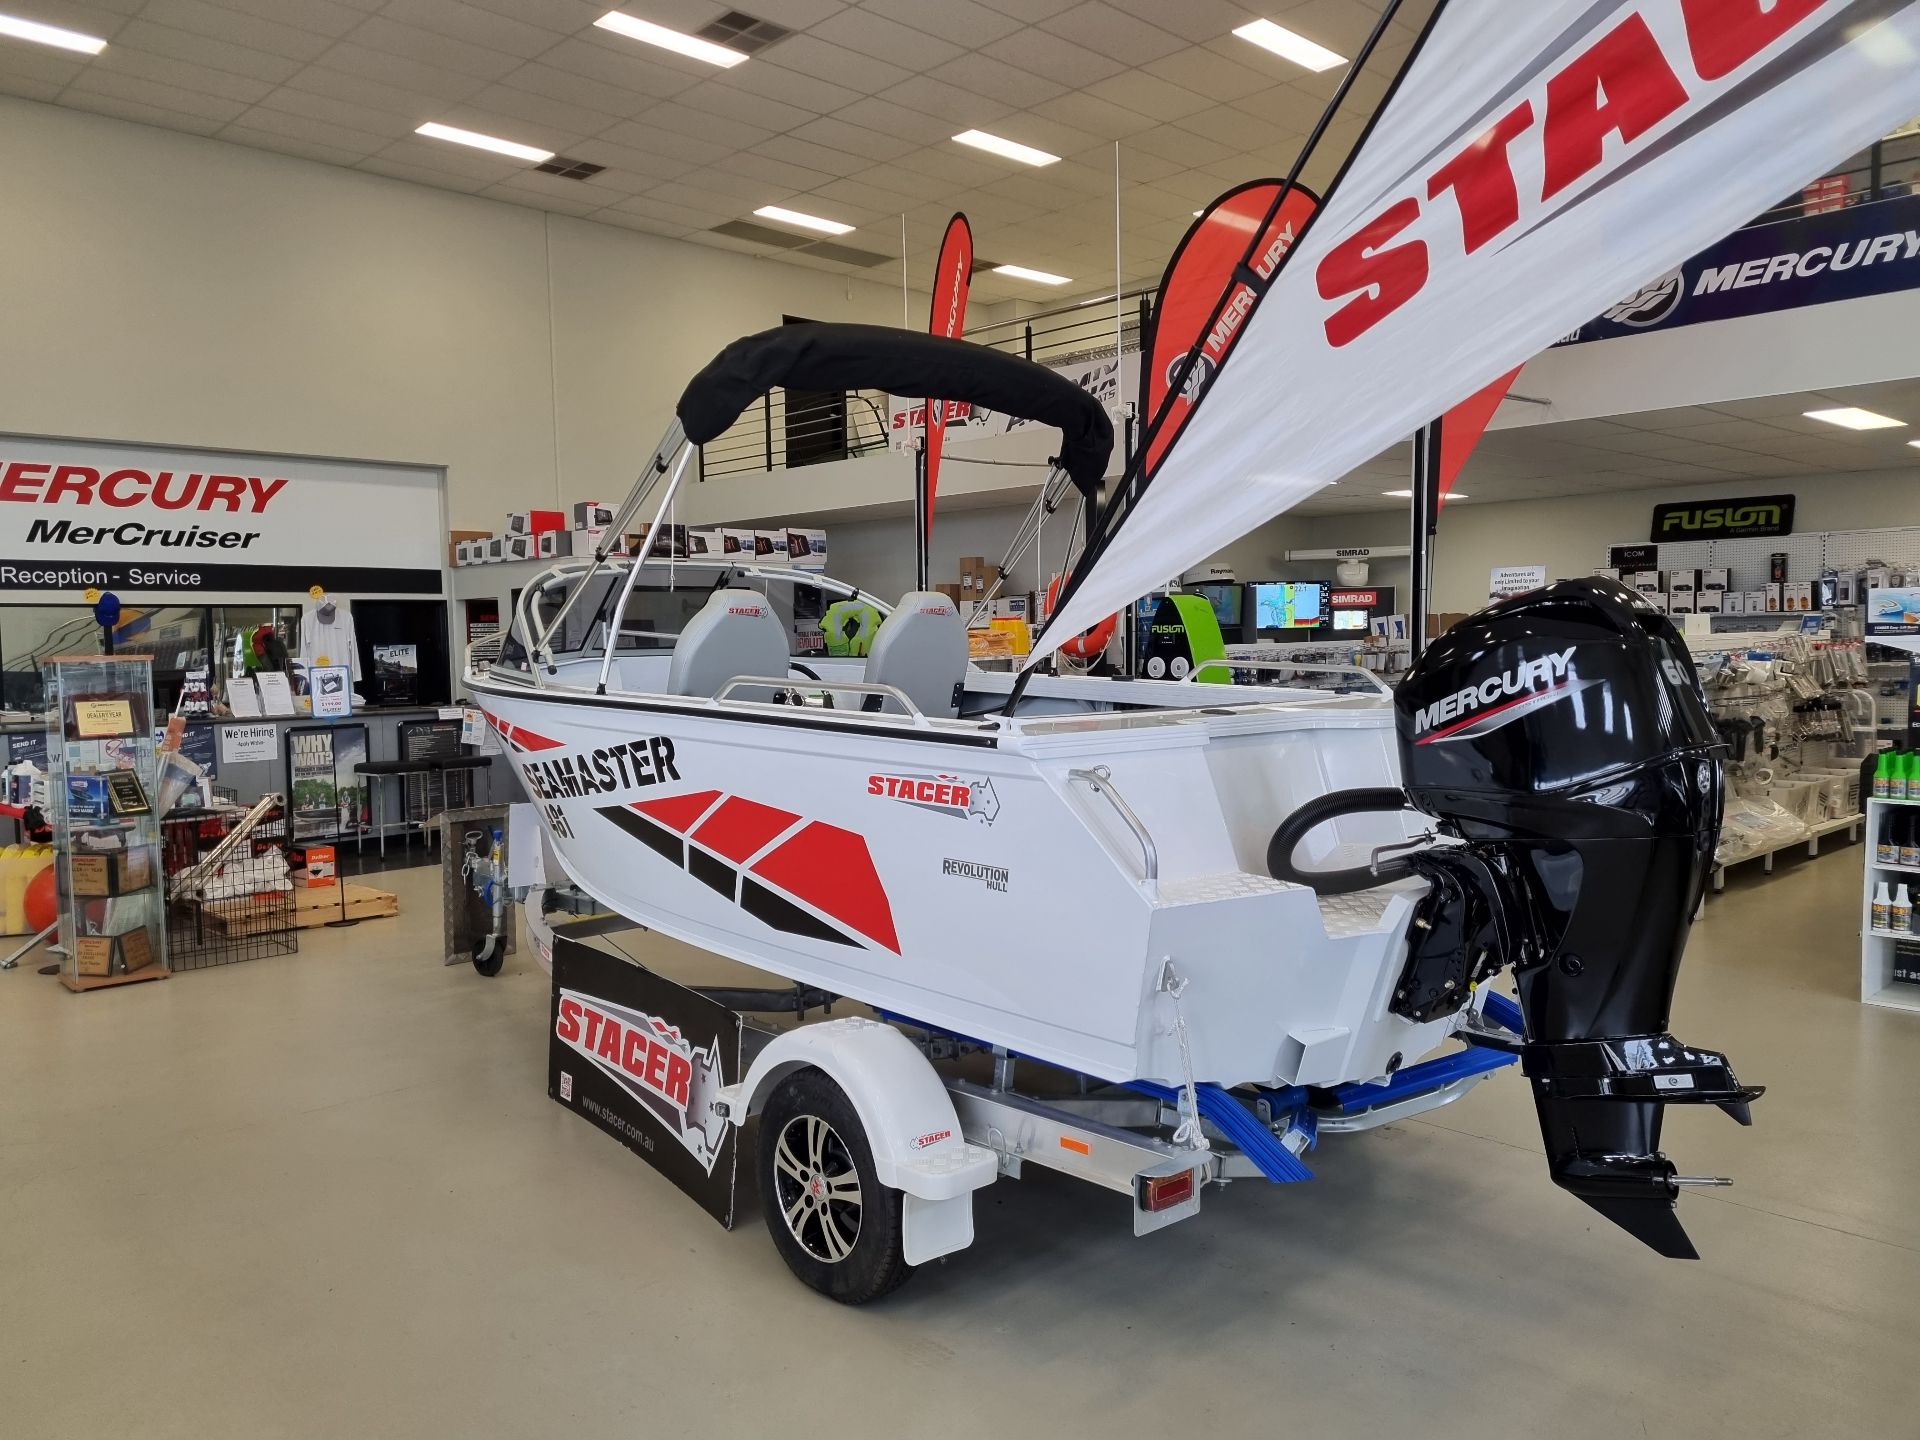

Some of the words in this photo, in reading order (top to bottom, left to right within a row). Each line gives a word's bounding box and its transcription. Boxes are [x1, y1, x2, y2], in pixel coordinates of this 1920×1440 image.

[1205, 220, 1295, 353] MERURY
[893, 400, 971, 430] STAER
[0, 462, 289, 514] ERCURY
[1663, 505, 1782, 532] FUSION
[26, 519, 260, 549] MerCruiser
[1, 567, 108, 587] Reception
[129, 569, 201, 585] Service
[1332, 595, 1373, 604] SIMRAD
[1152, 625, 1185, 633] FUSION
[390, 648, 410, 657] ELITE
[1661, 658, 1691, 686] 60
[1414, 645, 1577, 735] MERCURY
[12, 741, 29, 749] SEND
[225, 729, 248, 739] We're
[250, 728, 275, 739] Hiring
[293, 734, 332, 753] WHY
[294, 752, 333, 766] WAIT?
[522, 736, 681, 799] SEAMASTER
[867, 775, 971, 807] STACER
[942, 859, 1009, 883] REVOLUTION
[986, 880, 1008, 893] HULL
[557, 997, 693, 1110] STACER
[582, 1095, 655, 1152] www.stacer.com.au
[918, 1130, 951, 1146] STACER
